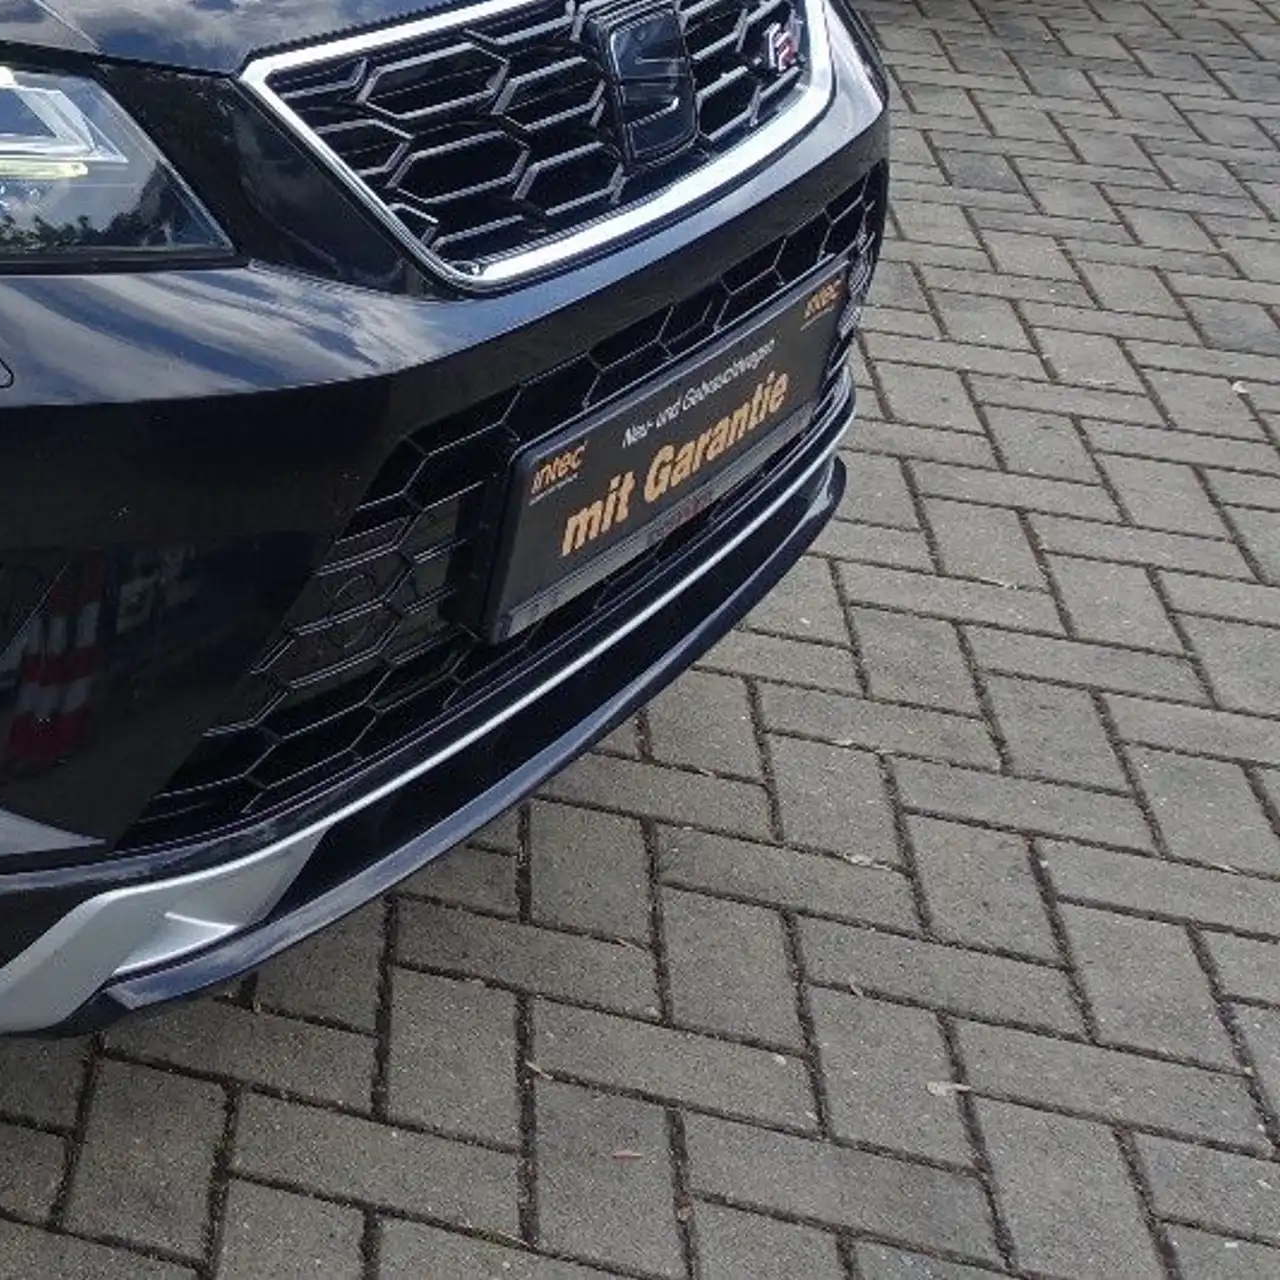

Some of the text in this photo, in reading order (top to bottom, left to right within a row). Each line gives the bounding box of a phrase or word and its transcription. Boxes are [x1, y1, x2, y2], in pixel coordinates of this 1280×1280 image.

[562, 472, 636, 557] mit
[643, 370, 789, 503] Garantie
[655, 397, 682, 429] und
